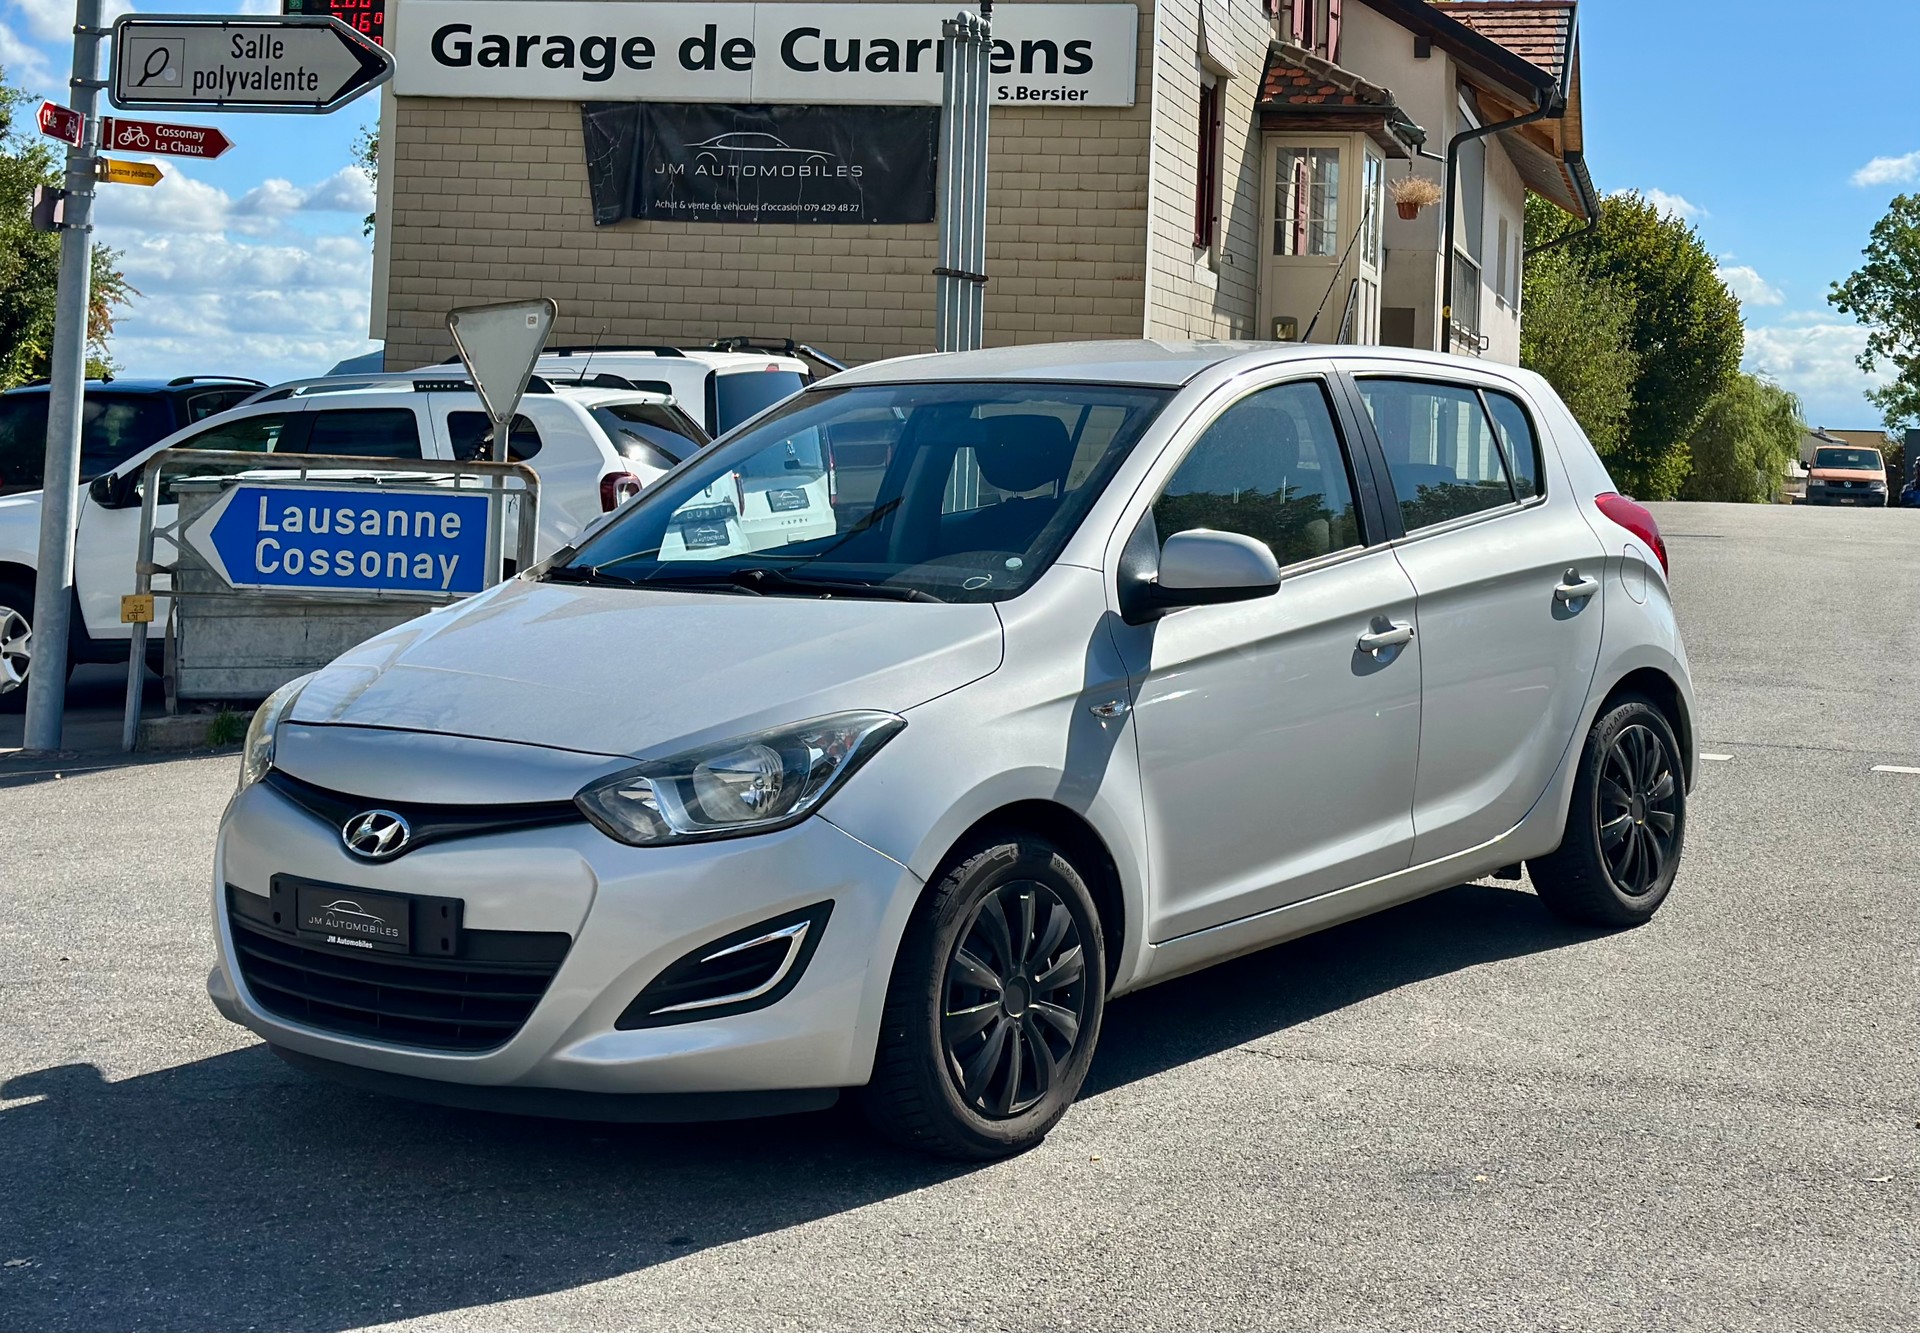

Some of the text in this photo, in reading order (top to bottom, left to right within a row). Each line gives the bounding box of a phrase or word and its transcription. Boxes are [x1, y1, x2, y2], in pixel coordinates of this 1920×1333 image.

[231, 33, 284, 59] Salle
[431, 24, 1094, 82] Garage de Cuarens
[193, 64, 318, 97] polyvalente
[997, 85, 1089, 101] S.Bersier
[156, 125, 205, 142] Cossonay
[155, 139, 204, 154] La Chaux
[654, 163, 863, 178] JM AUTOMOBILES
[655, 200, 859, 212] Achat & vente de véhicules d'occasion 079 429 48 27
[258, 496, 461, 538] Lausanne
[255, 537, 460, 590] Cossonay
[1602, 706, 1630, 743] POLARIS
[308, 916, 399, 937] JM AUTOMOBILES
[326, 935, 373, 949] JM Automobiles
